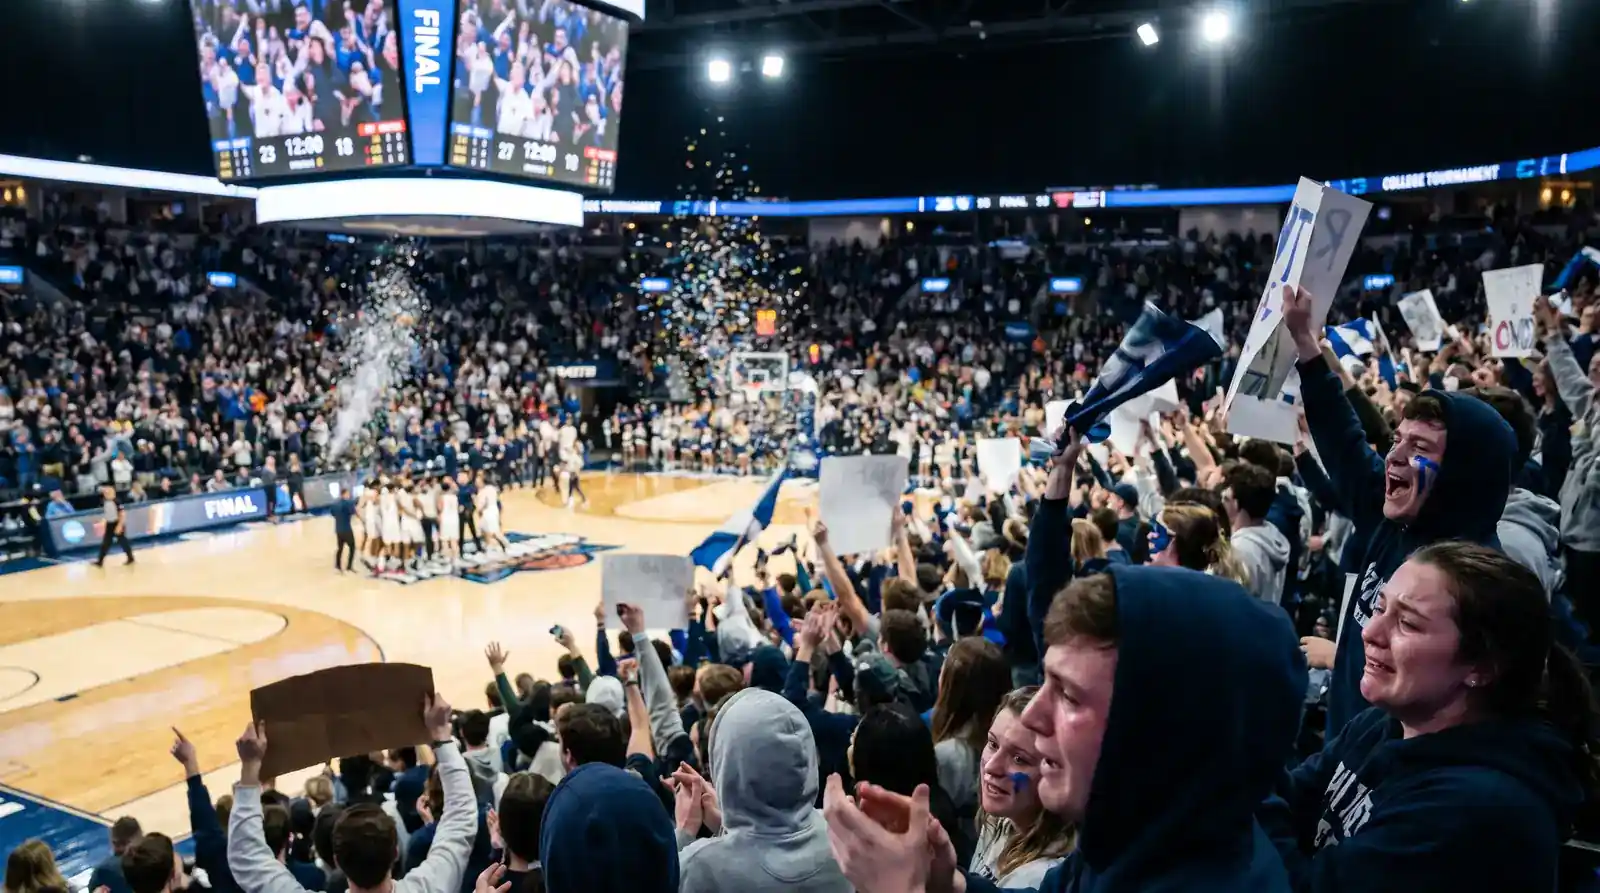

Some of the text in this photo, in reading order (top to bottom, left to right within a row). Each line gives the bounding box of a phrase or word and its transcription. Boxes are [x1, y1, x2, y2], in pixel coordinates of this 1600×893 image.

[414, 9, 440, 93] FINAL
[285, 135, 324, 156] 12:00
[1383, 164, 1500, 190] COLLEGE TOURNAMENT
[205, 495, 258, 519] FINAL
